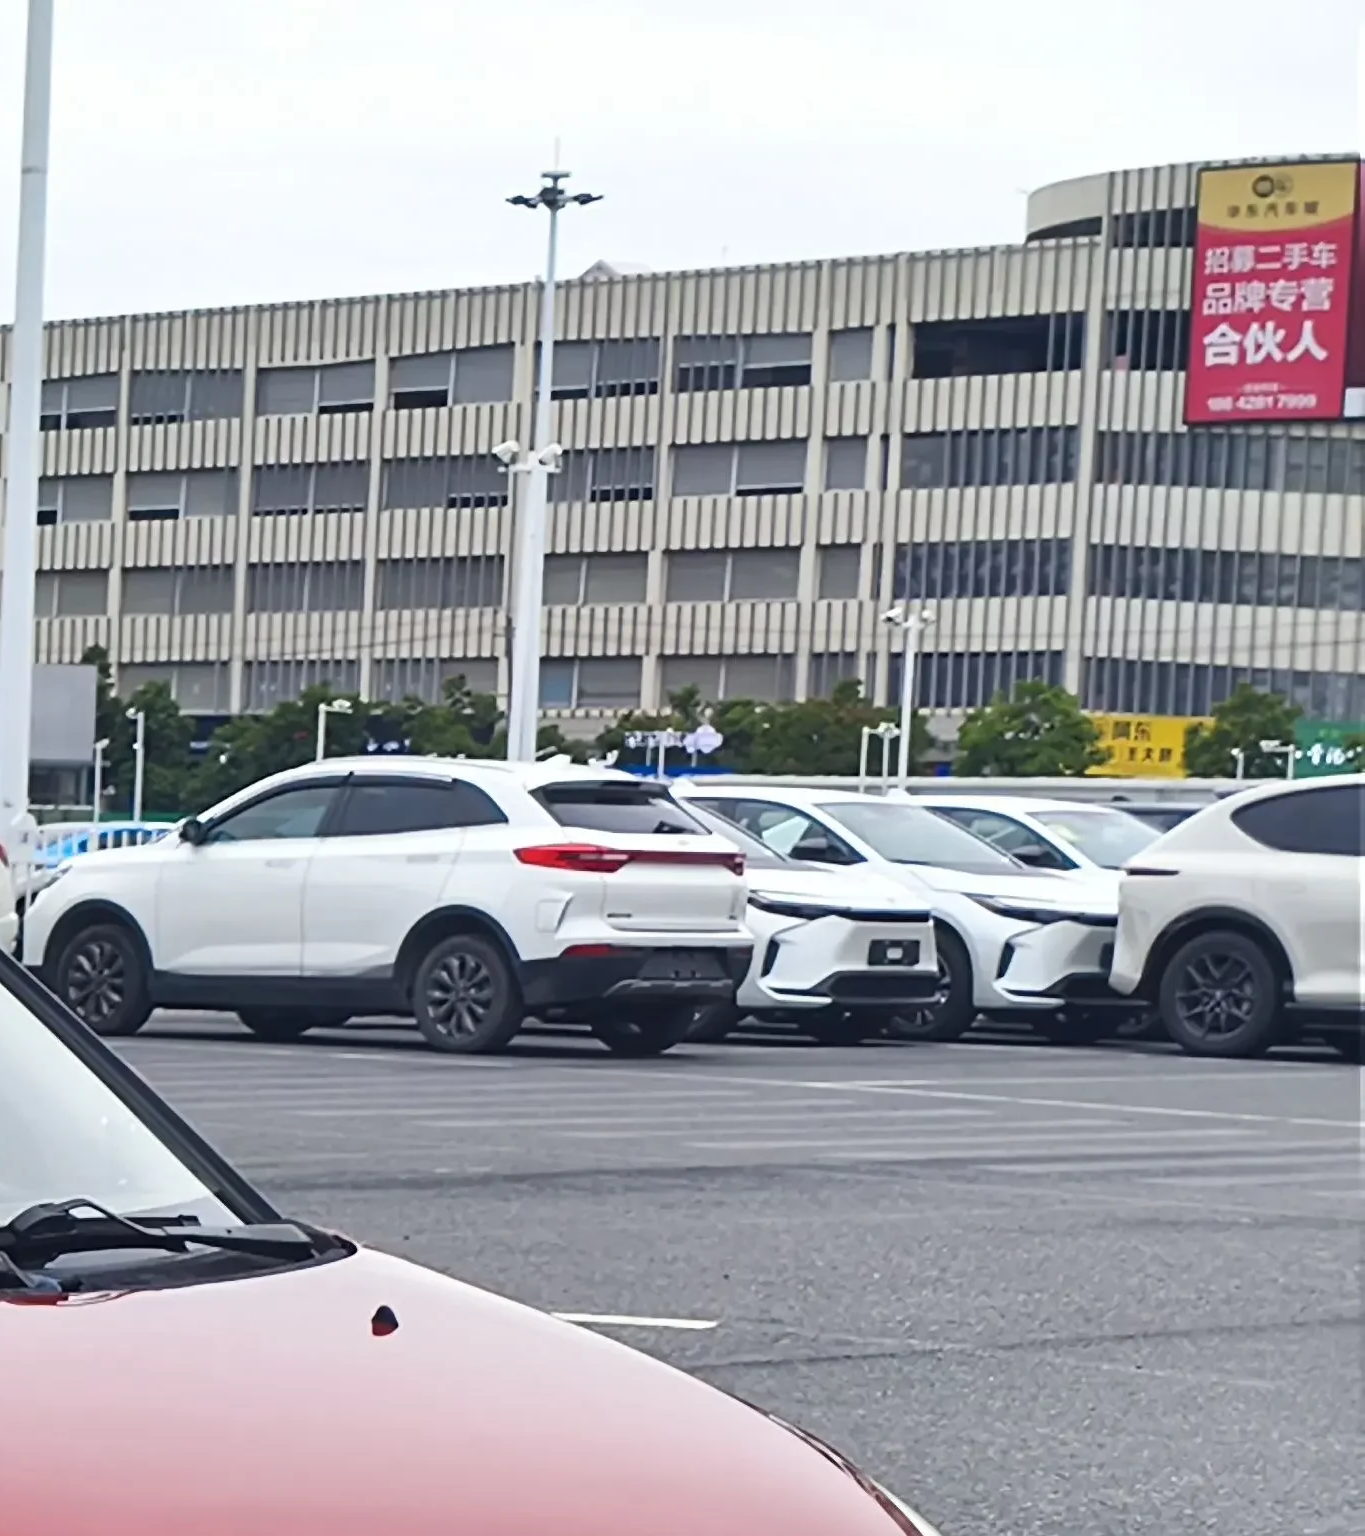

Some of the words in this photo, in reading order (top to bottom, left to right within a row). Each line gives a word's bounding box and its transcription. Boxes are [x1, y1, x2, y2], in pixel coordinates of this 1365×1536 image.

[1203, 242, 1337, 275] 招募二手车
[1202, 278, 1334, 316] 品牌专营
[1202, 320, 1328, 368] 合伙人
